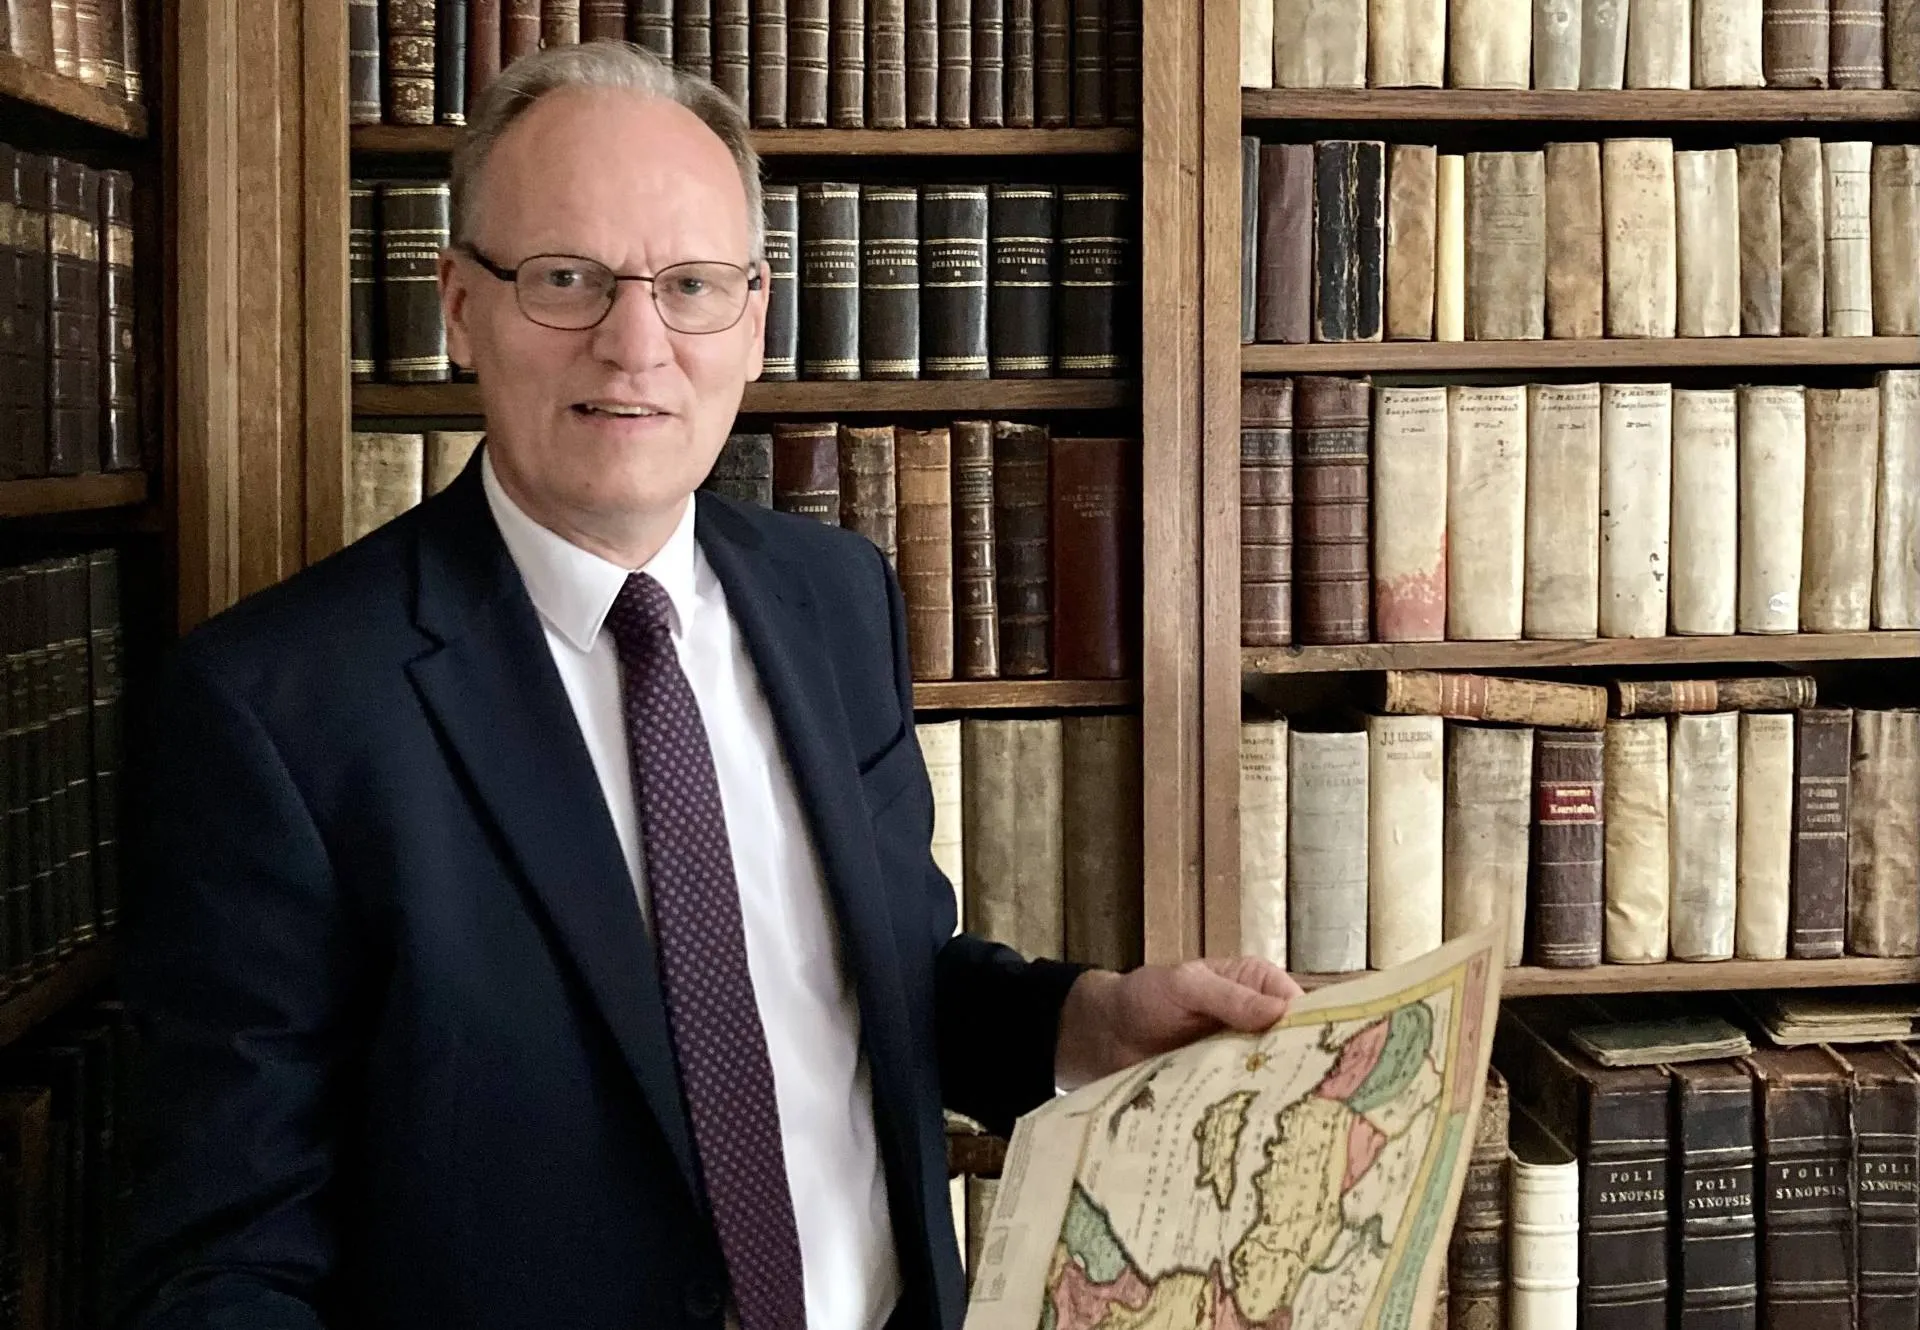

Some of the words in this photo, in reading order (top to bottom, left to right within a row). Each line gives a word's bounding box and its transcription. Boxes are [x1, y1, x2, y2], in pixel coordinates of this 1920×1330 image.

[1781, 1166, 1835, 1179] POLI
[1864, 1162, 1910, 1175] POLI
[1610, 1170, 1653, 1183] POLI
[1695, 1178, 1737, 1191] POLI
[1860, 1180, 1920, 1193] SYNOPSIS
[1600, 1189, 1665, 1203] SYNOPSIS
[1775, 1184, 1846, 1200] SYNOPSIS
[1688, 1194, 1752, 1209] SYNOPSIS
